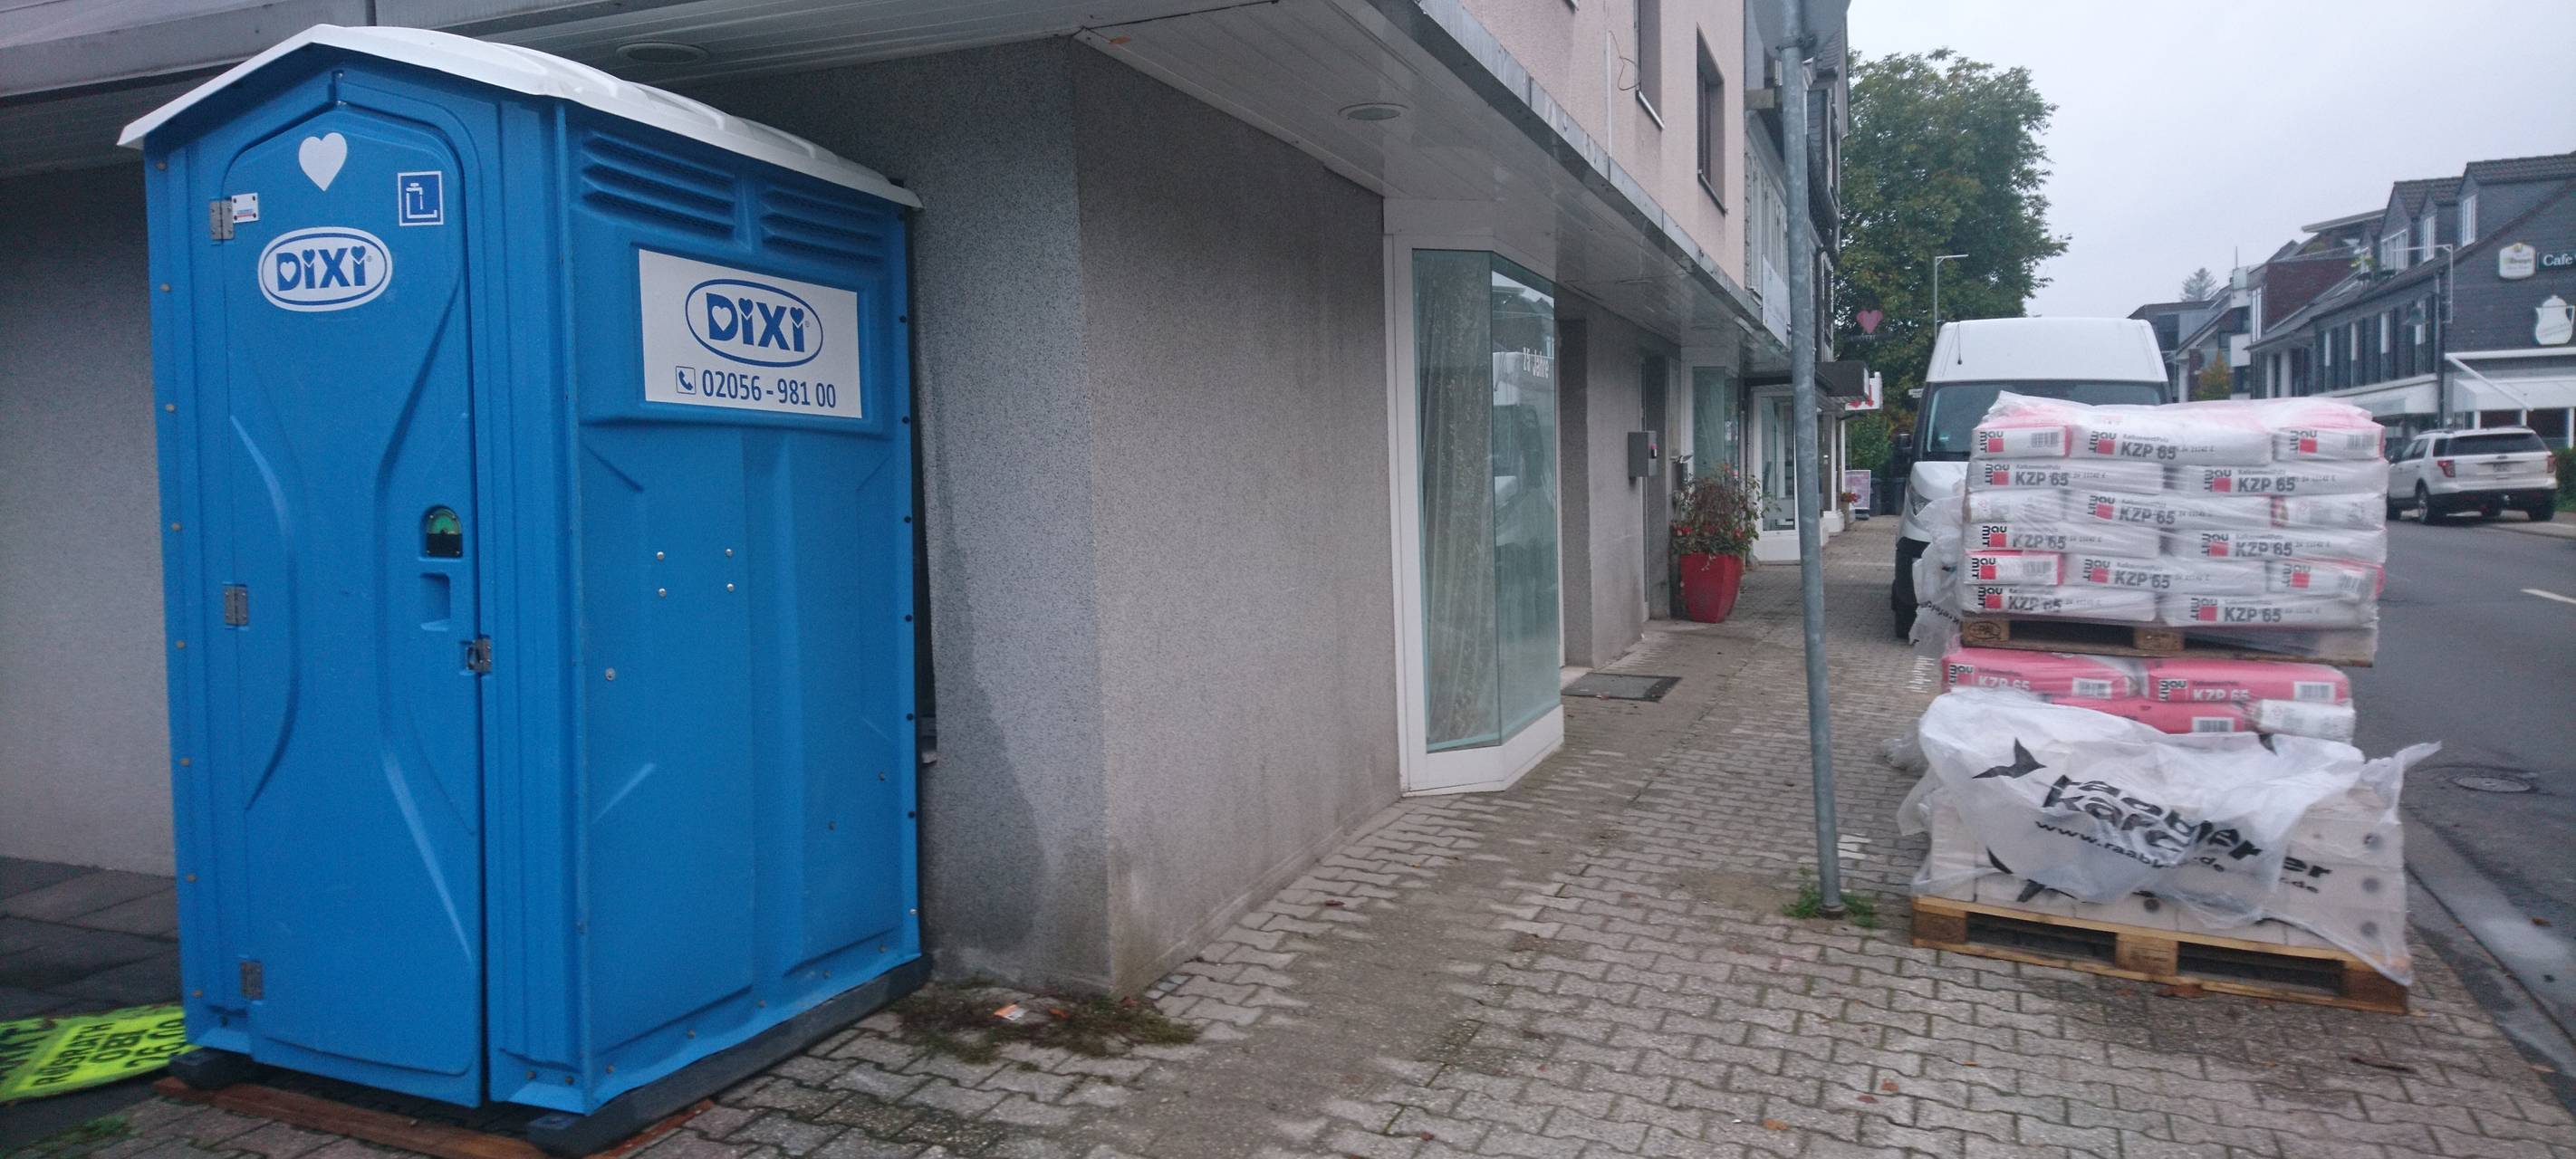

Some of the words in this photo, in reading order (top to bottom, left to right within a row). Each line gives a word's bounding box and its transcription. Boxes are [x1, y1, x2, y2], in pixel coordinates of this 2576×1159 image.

[2543, 254, 2572, 266] Cafe
[1532, 349, 1549, 379] Jahre
[2120, 441, 2153, 457] KZP
[2157, 445, 2177, 460] 65
[2015, 472, 2046, 485] KZP
[2050, 472, 2069, 486] 65
[2238, 477, 2272, 493] KZP
[2276, 477, 2296, 492] 65
[2119, 507, 2152, 522] KZP
[2156, 510, 2176, 524] 65
[2013, 534, 2044, 548] KZP
[2047, 535, 2066, 550] 65
[2235, 542, 2268, 557] KZP
[2273, 542, 2292, 557] 65
[2114, 570, 2148, 586] KZP
[2150, 573, 2171, 589] 65
[2225, 608, 2257, 622] KZP
[2264, 608, 2282, 622] 65
